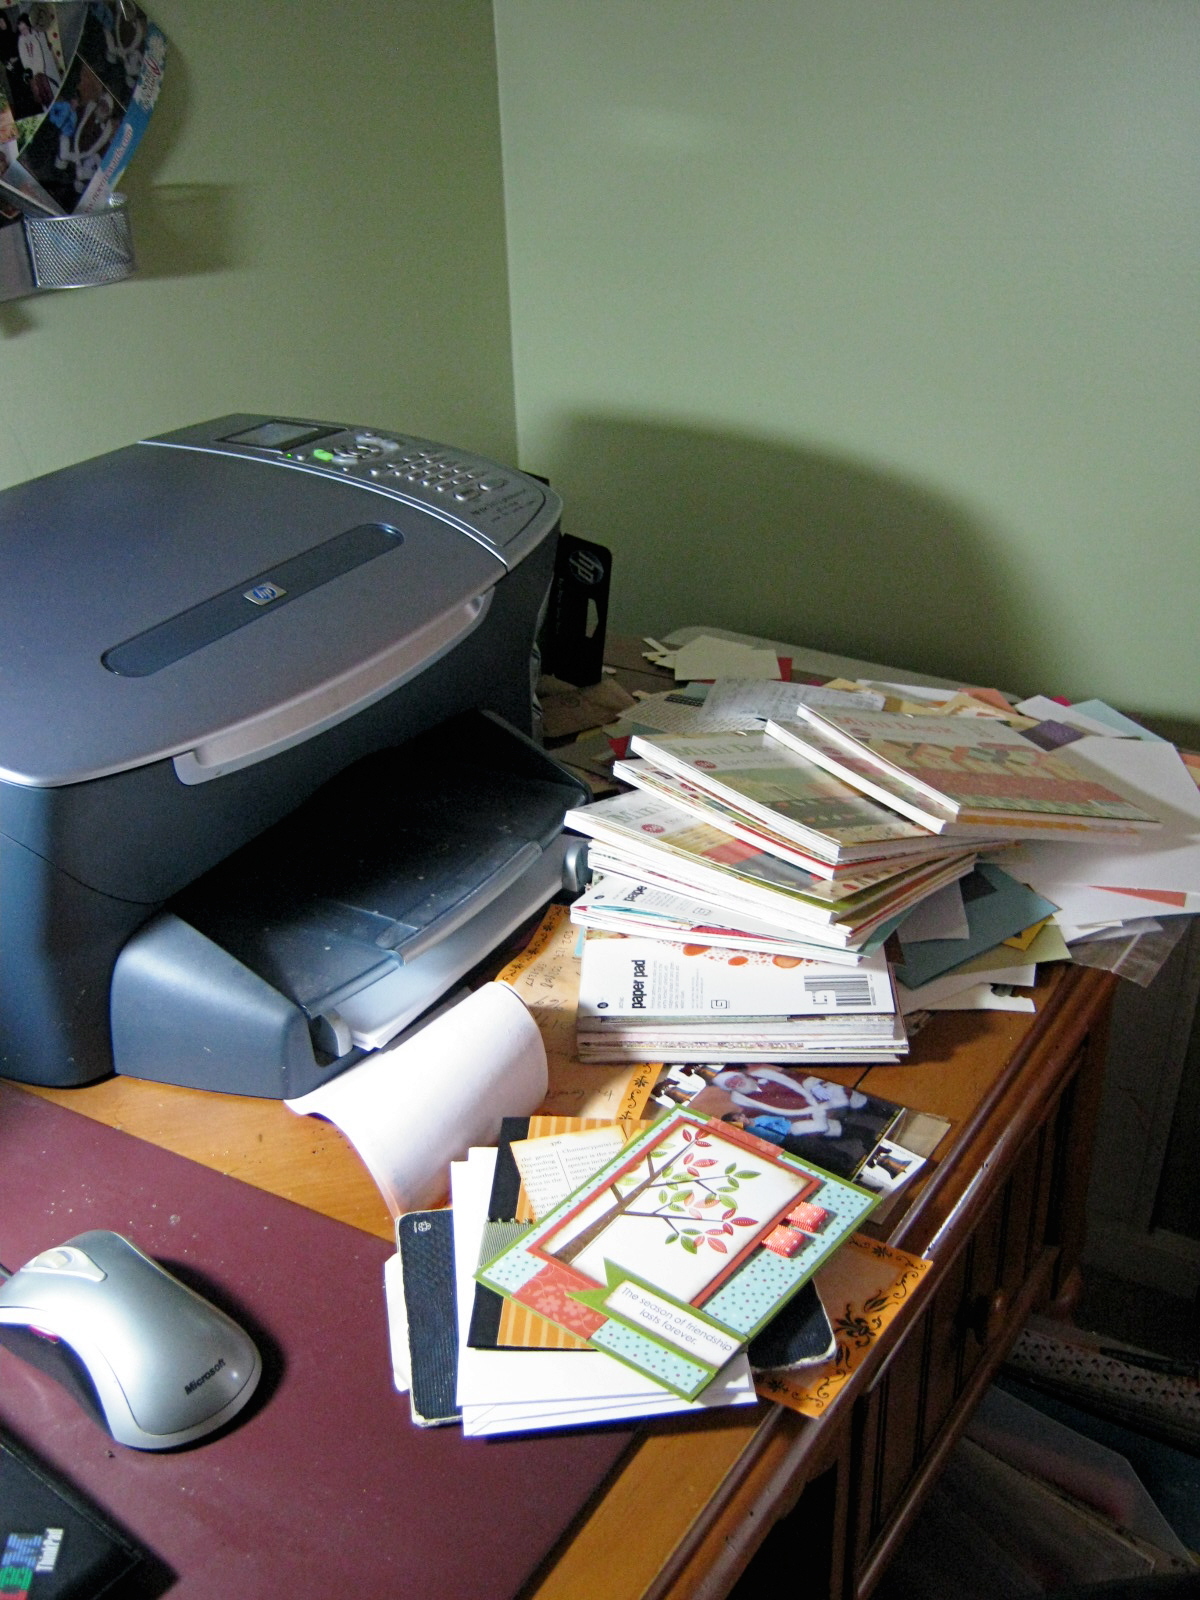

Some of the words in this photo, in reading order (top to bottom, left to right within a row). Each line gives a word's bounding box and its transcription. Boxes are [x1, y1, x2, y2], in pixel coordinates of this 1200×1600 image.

[567, 549, 605, 585] hp
[623, 885, 647, 902] pape
[631, 959, 648, 978] pad
[631, 980, 647, 1009] paper
[521, 1160, 556, 1168] Depending
[621, 1287, 639, 1300] The
[639, 1298, 673, 1319] season
[674, 1315, 687, 1327] of
[686, 1321, 732, 1351] friendship
[639, 1309, 661, 1325] lasts
[661, 1321, 696, 1345] forever.
[184, 1358, 226, 1396] Microsoft
